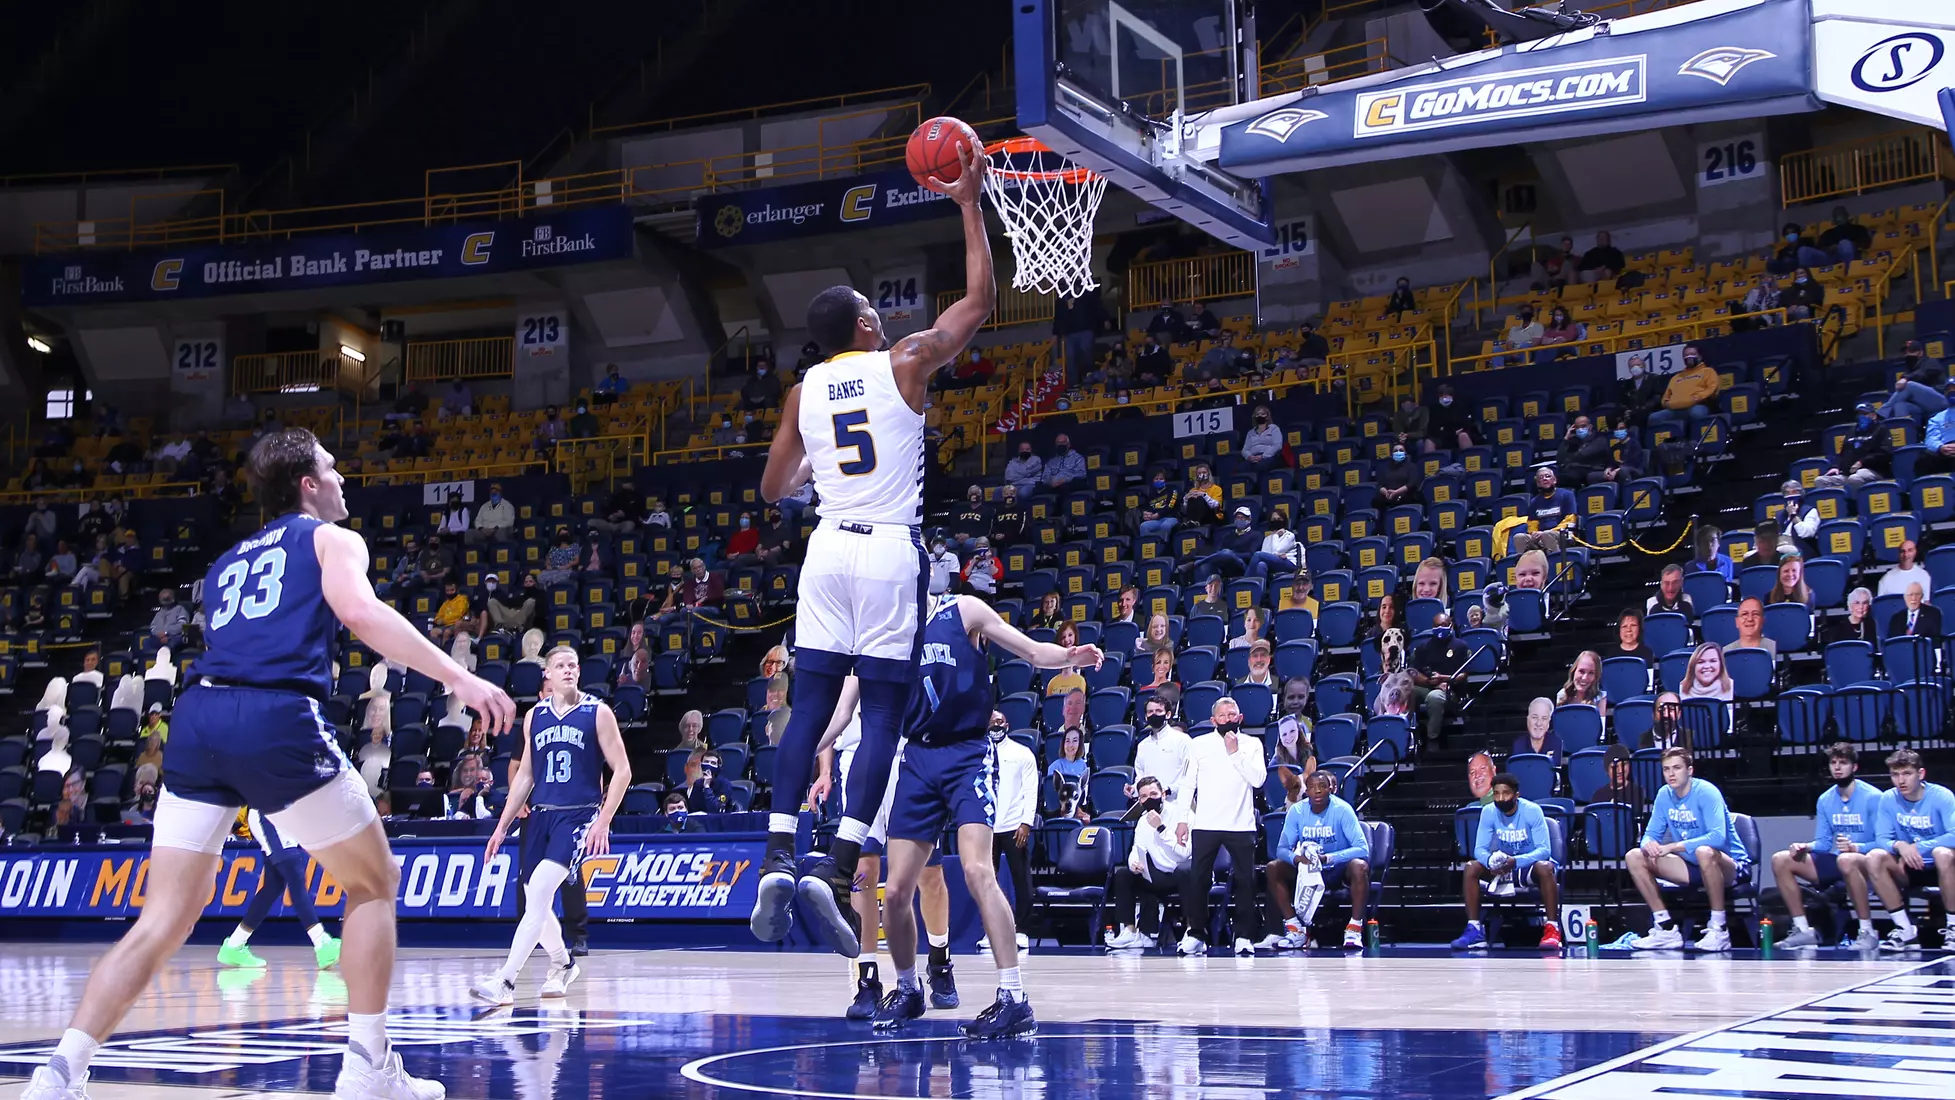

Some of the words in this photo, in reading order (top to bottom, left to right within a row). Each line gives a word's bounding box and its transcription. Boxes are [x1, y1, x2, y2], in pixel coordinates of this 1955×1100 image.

[1704, 140, 1756, 181] 216
[746, 203, 825, 225] erlanger
[521, 233, 596, 258] FirstBank
[203, 256, 284, 284] Official
[290, 251, 348, 278] Bank
[354, 248, 444, 272] Partner
[52, 275, 125, 296] FirstBank
[878, 277, 919, 309] 214
[523, 316, 560, 345] 213
[178, 342, 218, 369] 212
[827, 379, 866, 402] BANKS
[1183, 411, 1221, 434] 115
[830, 407, 878, 478] 5
[210, 546, 288, 631] 33
[534, 724, 586, 752] CITADEL
[545, 749, 572, 783] 13
[616, 852, 714, 883] MOCS
[699, 858, 751, 889] FLY
[613, 884, 733, 907] TOGETHER
[1567, 909, 1584, 939] 6
